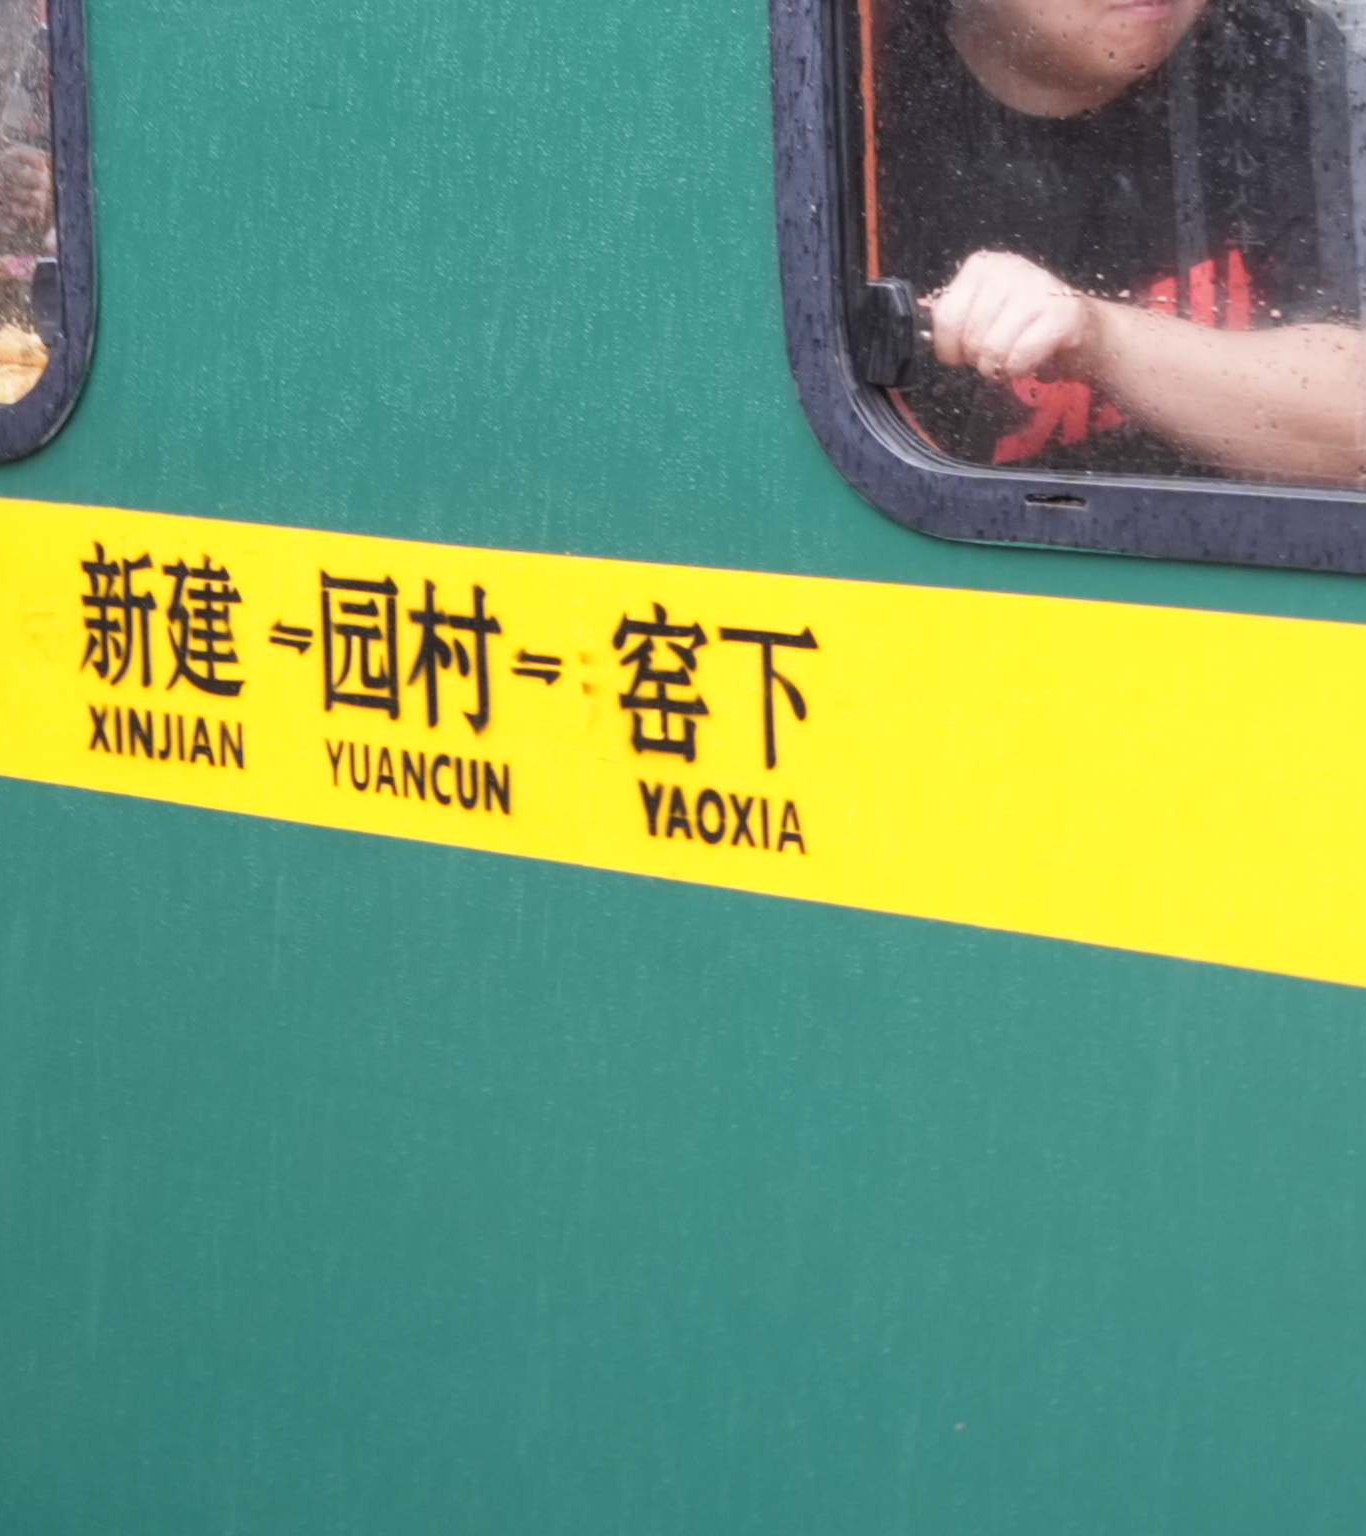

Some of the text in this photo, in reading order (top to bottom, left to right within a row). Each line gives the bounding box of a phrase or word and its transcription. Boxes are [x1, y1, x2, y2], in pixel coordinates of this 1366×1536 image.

[80, 541, 819, 769] 新建 园村 窑下
[88, 706, 805, 853] XINJIAN YUANCUN YAOXIA
